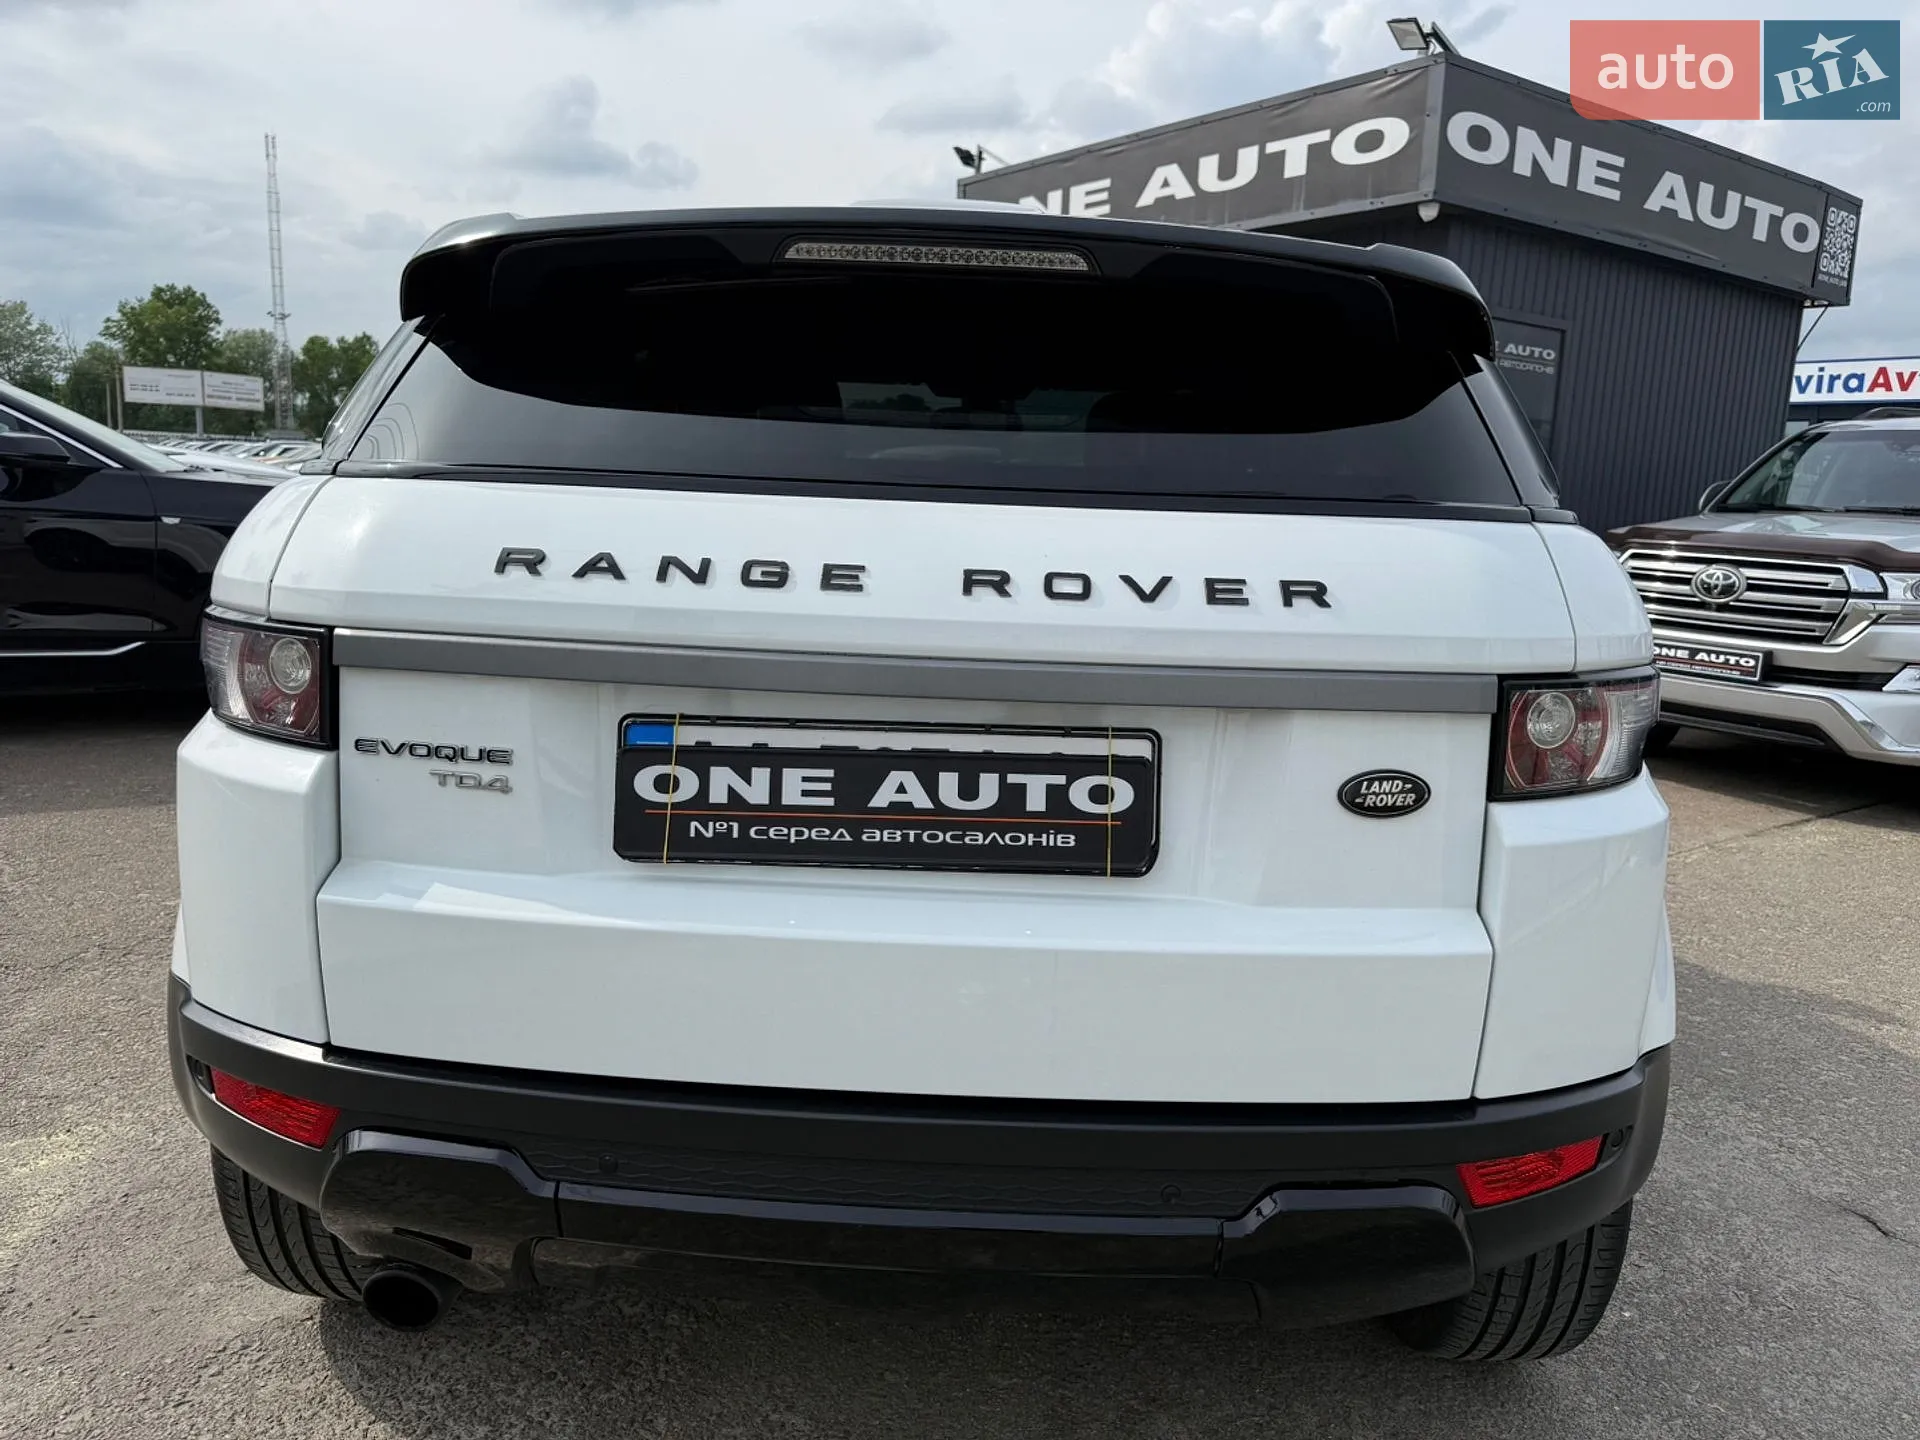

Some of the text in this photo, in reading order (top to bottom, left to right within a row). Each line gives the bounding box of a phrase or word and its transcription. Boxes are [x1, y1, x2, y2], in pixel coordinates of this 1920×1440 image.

[1135, 117, 1411, 208] AUTO
[1446, 111, 1821, 254] ONE AUTO
[1504, 343, 1556, 360] AUTO
[1794, 366, 1920, 396] viraAv
[494, 546, 1333, 608] RANGE ROVER
[1695, 652, 1756, 667] AUTO
[354, 738, 514, 766] EVOQUE
[429, 769, 513, 794] TD4
[633, 764, 1136, 815] ONE AUTO
[1360, 780, 1404, 794] LAND
[1364, 793, 1417, 807] ROVER
[749, 825, 854, 844] серед
[860, 828, 1077, 848] автосалонів
